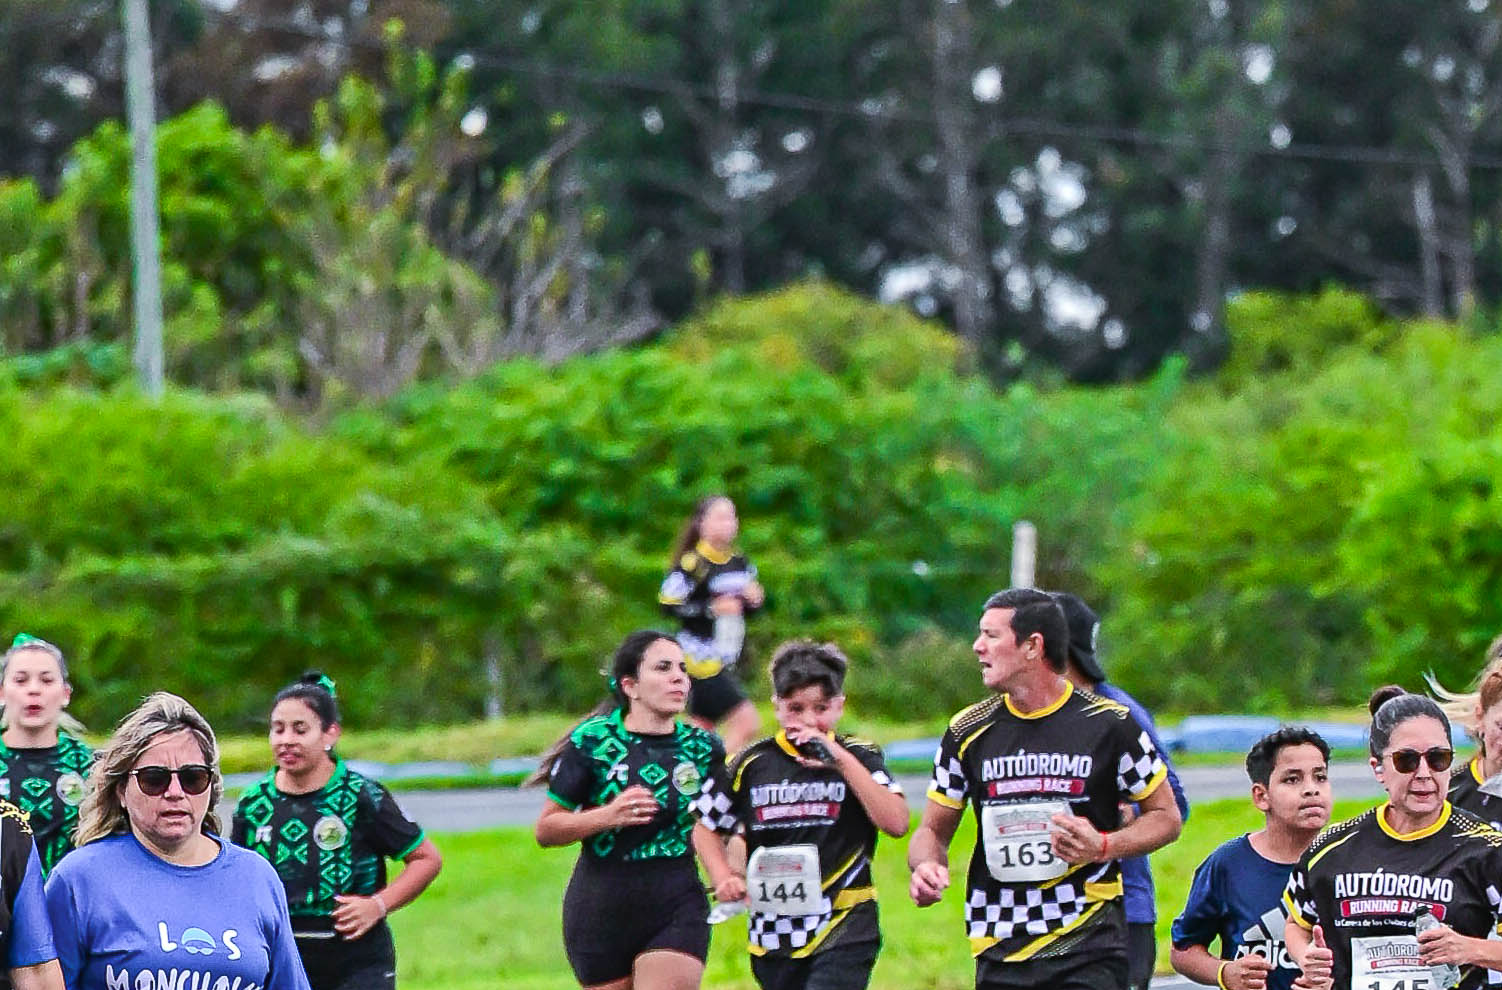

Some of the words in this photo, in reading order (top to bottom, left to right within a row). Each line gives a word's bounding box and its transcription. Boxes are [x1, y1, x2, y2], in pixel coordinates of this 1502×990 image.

[982, 748, 1093, 782] AUTÓDROMO
[999, 841, 1055, 868] 163
[758, 882, 807, 903] 144
[1335, 867, 1454, 903] AUTÓDROMO
[1350, 900, 1399, 915] RUNNING
